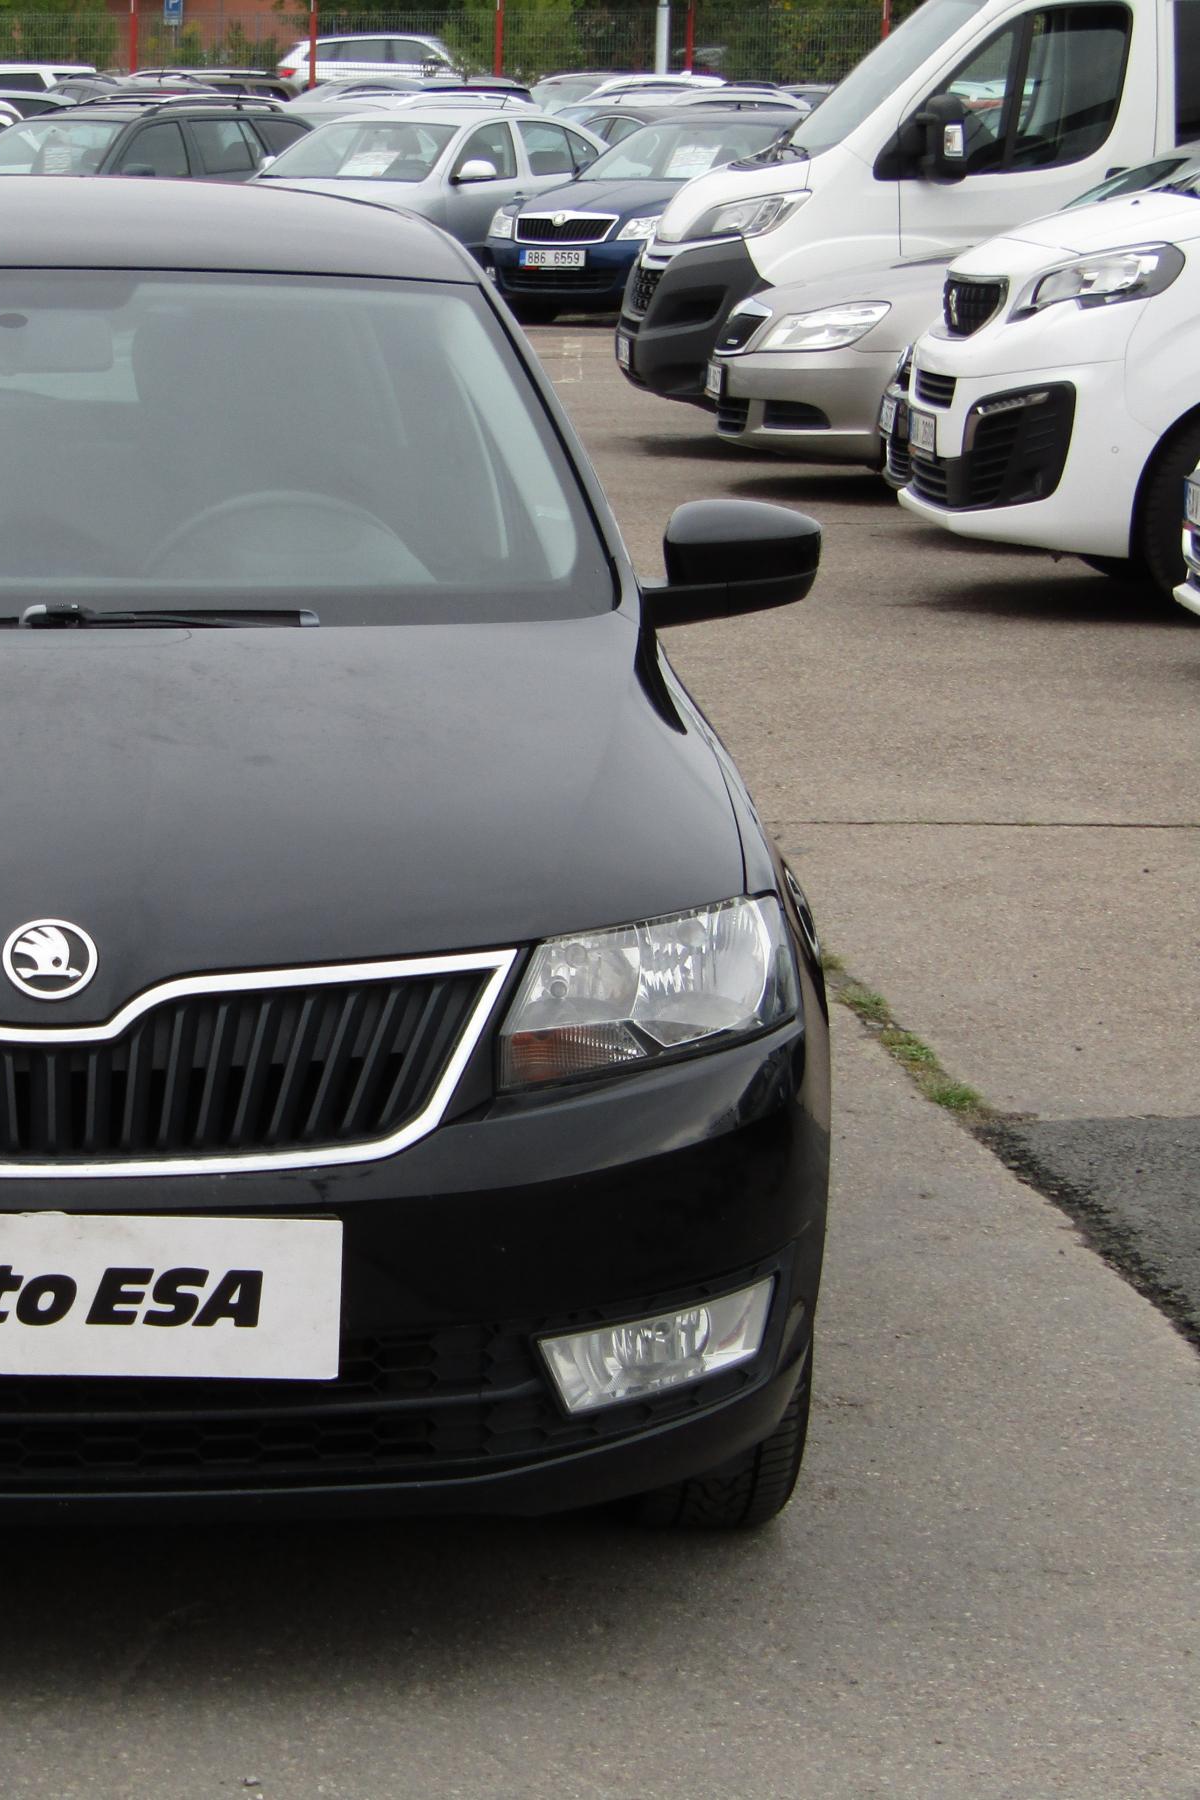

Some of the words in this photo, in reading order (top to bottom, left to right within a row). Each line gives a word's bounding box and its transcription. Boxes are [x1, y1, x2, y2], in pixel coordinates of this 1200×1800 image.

[527, 252, 546, 264] 8B6
[553, 252, 580, 265] 6559
[85, 1267, 263, 1328] ESA
